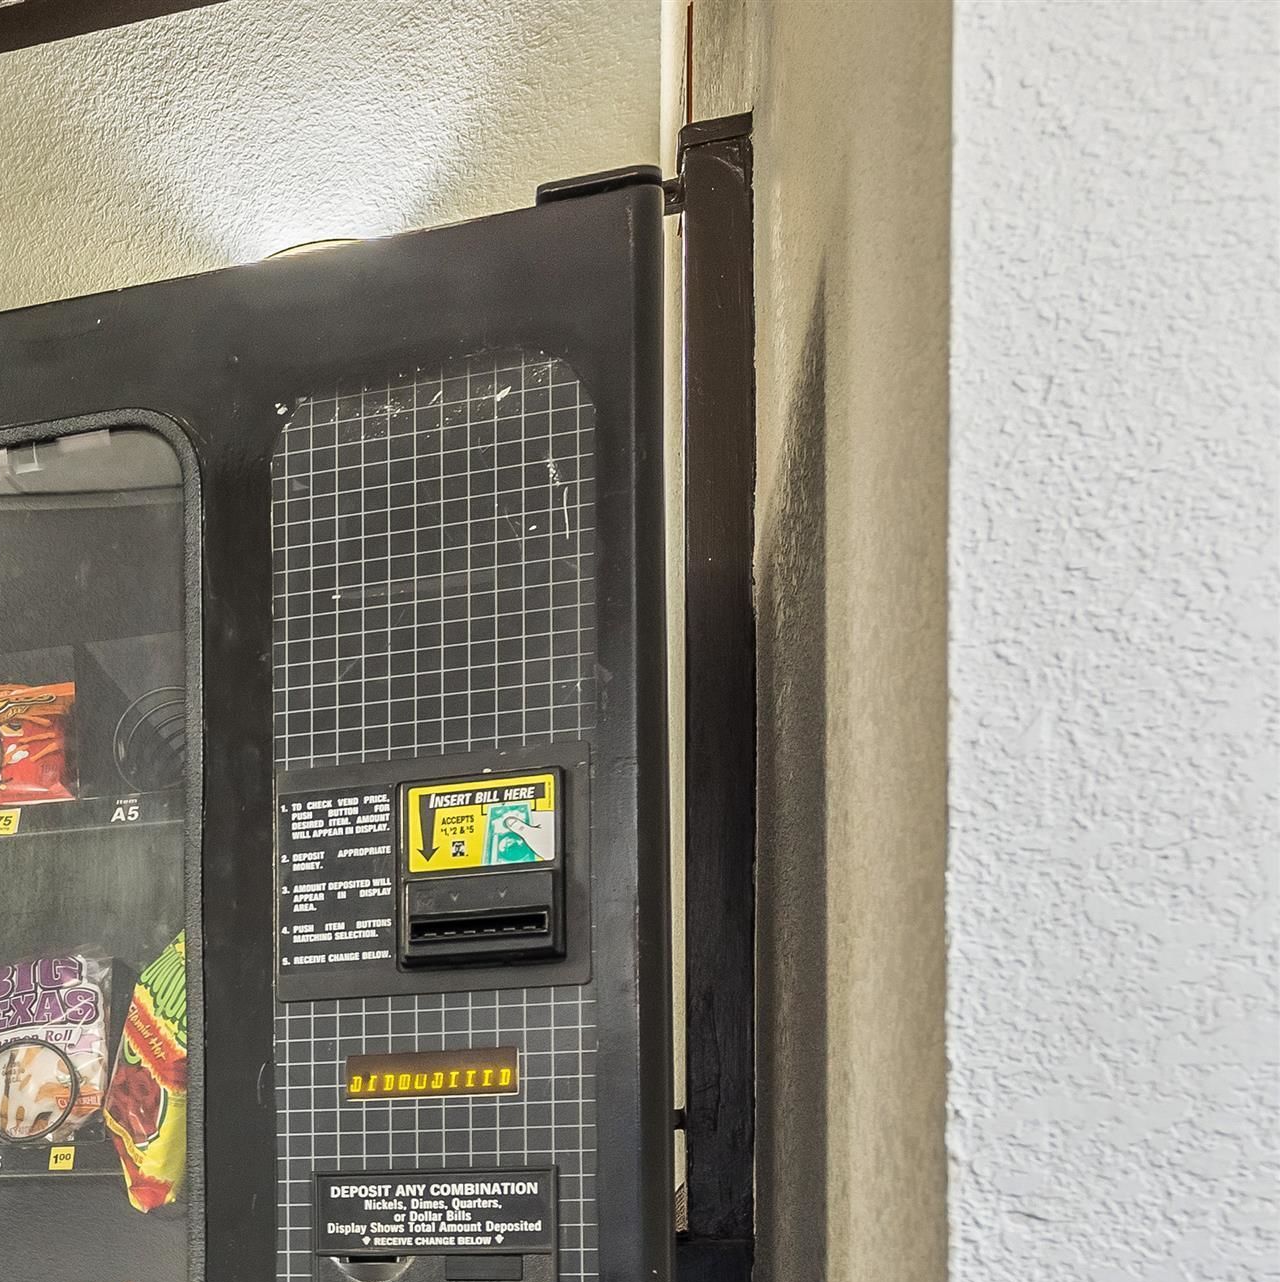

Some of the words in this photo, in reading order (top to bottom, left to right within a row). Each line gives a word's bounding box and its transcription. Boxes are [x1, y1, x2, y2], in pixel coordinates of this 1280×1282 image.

[280, 805, 288, 813] 1.
[291, 803, 302, 811] TO
[306, 800, 332, 810] CHECK
[337, 797, 359, 806] VEND
[363, 794, 390, 804] PRICE.
[429, 793, 472, 809] INSERT
[475, 790, 500, 804] BILL
[504, 786, 535, 801] HERE
[111, 806, 140, 822] A5
[291, 811, 313, 821] PUSH
[328, 807, 359, 817] BUTTON
[374, 804, 390, 813] FOR
[441, 814, 474, 825] ACCEPTS
[291, 820, 324, 830] DESIRED
[328, 817, 351, 827] ITEM.
[356, 813, 390, 824] AMOUNT
[291, 830, 311, 840] WILL
[312, 827, 343, 838] APPEAR
[345, 826, 354, 835] IN
[355, 823, 390, 834] DISPLAY.
[459, 826, 465, 834] &
[280, 854, 289, 863] 2.
[292, 851, 325, 862] DEPOSIT
[337, 845, 391, 858] APPROPRIATE
[292, 861, 323, 871] MONEY.
[281, 886, 290, 895] 3.
[293, 883, 326, 893] AMOUNT
[328, 879, 371, 891] DEPOSITED
[372, 878, 392, 887] WILL
[293, 893, 324, 903] APPEAR
[337, 890, 347, 899] IN
[359, 887, 392, 898] DISPLAY
[293, 903, 317, 913] AREA.
[281, 926, 290, 935] 4.
[293, 924, 314, 934] PUSH
[325, 922, 345, 931] ITEM
[356, 918, 392, 929] BUTTONS
[293, 932, 332, 943] MATCHING
[334, 929, 379, 940] SELECTION.
[293, 954, 326, 965] RECEIVE
[328, 952, 360, 963] CHANGE
[361, 950, 392, 960] BELOW.
[44, 1029, 73, 1042] Roll
[330, 1184, 392, 1198] DEPOSIT
[395, 1184, 426, 1197] ANY
[429, 1182, 538, 1196] COMBINATION
[364, 1199, 407, 1210] Nickels,
[410, 1198, 448, 1210] Dimes,
[451, 1197, 502, 1210] Quarters,
[393, 1213, 406, 1222] or
[409, 1210, 443, 1222] Dollar
[446, 1210, 472, 1221] Bills
[327, 1222, 367, 1235] Display
[370, 1222, 404, 1233] Shows
[407, 1221, 435, 1233] Total
[439, 1221, 482, 1232] Amount
[485, 1220, 542, 1234] Deposited
[373, 1237, 413, 1246] RECEIVE
[414, 1237, 456, 1246] CHANGE
[457, 1236, 492, 1245] BELOW
